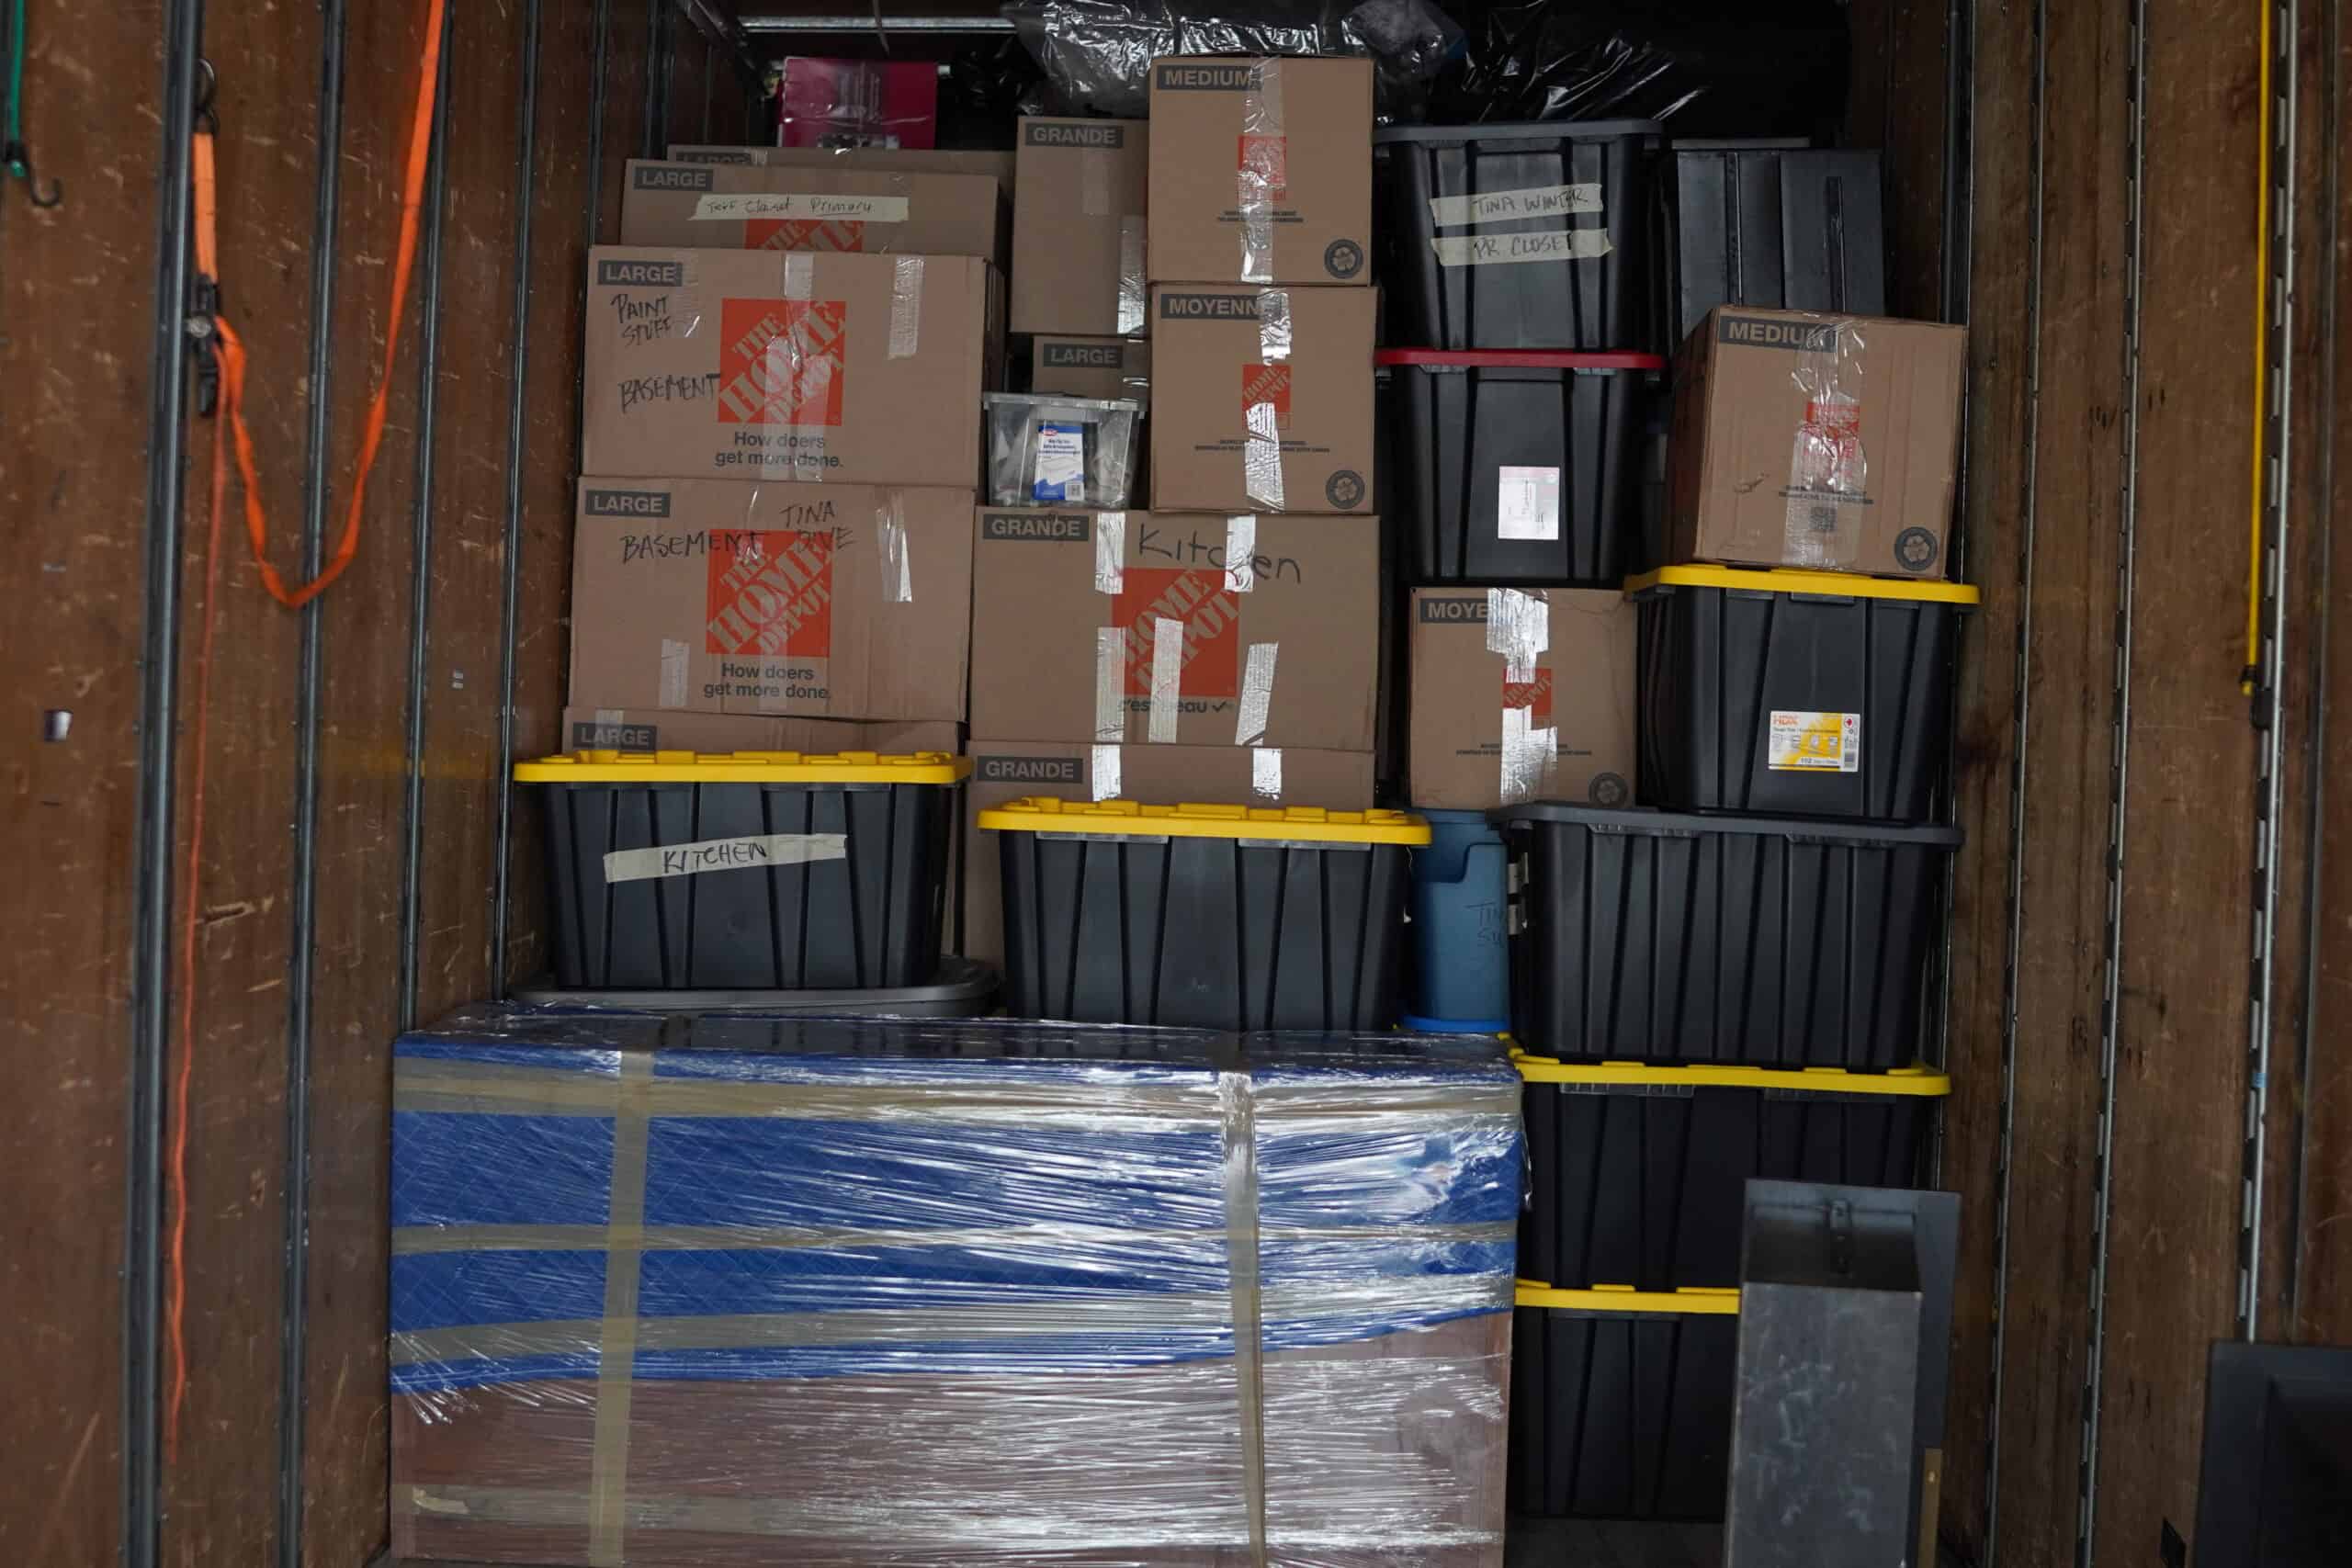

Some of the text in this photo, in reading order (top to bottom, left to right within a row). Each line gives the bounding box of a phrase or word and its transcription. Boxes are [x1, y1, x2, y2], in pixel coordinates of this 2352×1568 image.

[1033, 127, 1116, 145] GRANDE
[642, 170, 707, 187] LARGE
[1472, 197, 1516, 217] TINA
[1511, 232, 1573, 257] CLOSET
[605, 264, 676, 282] LARGE
[610, 294, 670, 324] PAINT
[1168, 297, 1262, 315] MOYENN
[621, 316, 673, 346] STUFF
[1050, 348, 1114, 365] LARGE
[617, 373, 721, 414] BASEMENT
[734, 431, 825, 448] How doers
[715, 450, 743, 467] get
[594, 495, 662, 513] LARGE
[780, 502, 836, 528] TINA
[991, 517, 1081, 537] GRANDE
[619, 530, 771, 564] BASEMENT
[1138, 523, 1301, 585] Kitcen
[707, 537, 831, 654] HOME
[721, 661, 815, 681] How doers
[704, 682, 732, 699] get
[735, 684, 781, 698] more
[581, 727, 650, 746] LARGE
[985, 761, 1074, 778] GRANDE
[662, 842, 767, 874] KITCHEN
